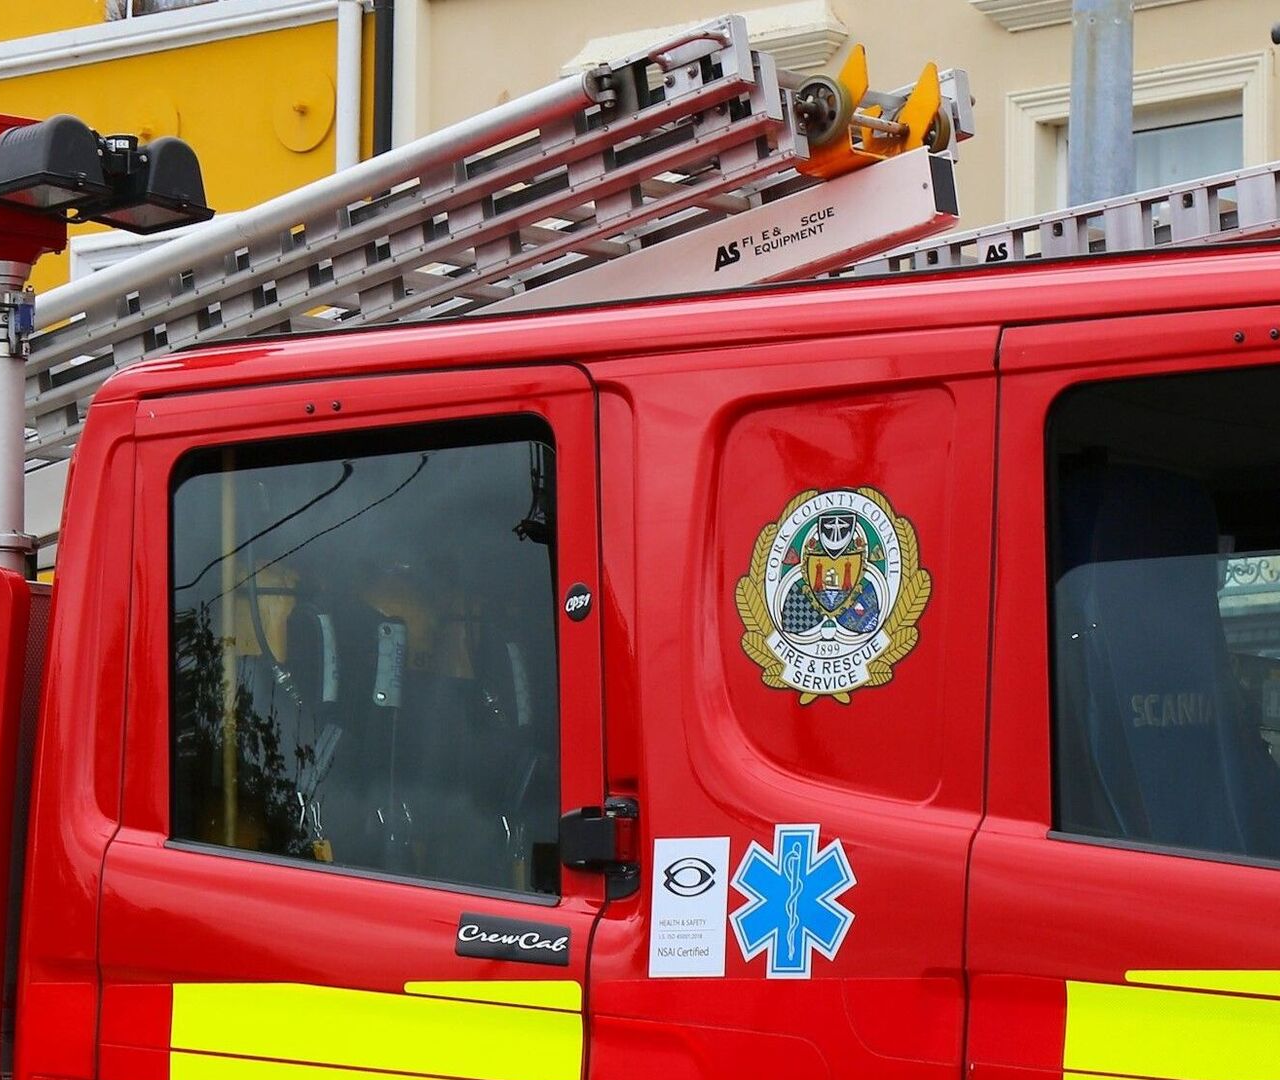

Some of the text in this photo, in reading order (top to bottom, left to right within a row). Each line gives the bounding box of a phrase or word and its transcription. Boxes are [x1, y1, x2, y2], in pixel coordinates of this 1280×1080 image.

[742, 207, 835, 248] FIE & SCUE
[754, 223, 825, 256] EQUIPMENT
[714, 241, 741, 272] AS
[985, 242, 1008, 263] AS
[768, 493, 900, 582] CORK COUNTY COUNCIL
[774, 639, 882, 674] FIRE & RESCUE
[815, 643, 840, 656] 1899
[792, 670, 859, 690] SERVICE
[659, 919, 679, 927] HEALTH
[657, 946, 709, 957] NSAI Certified
